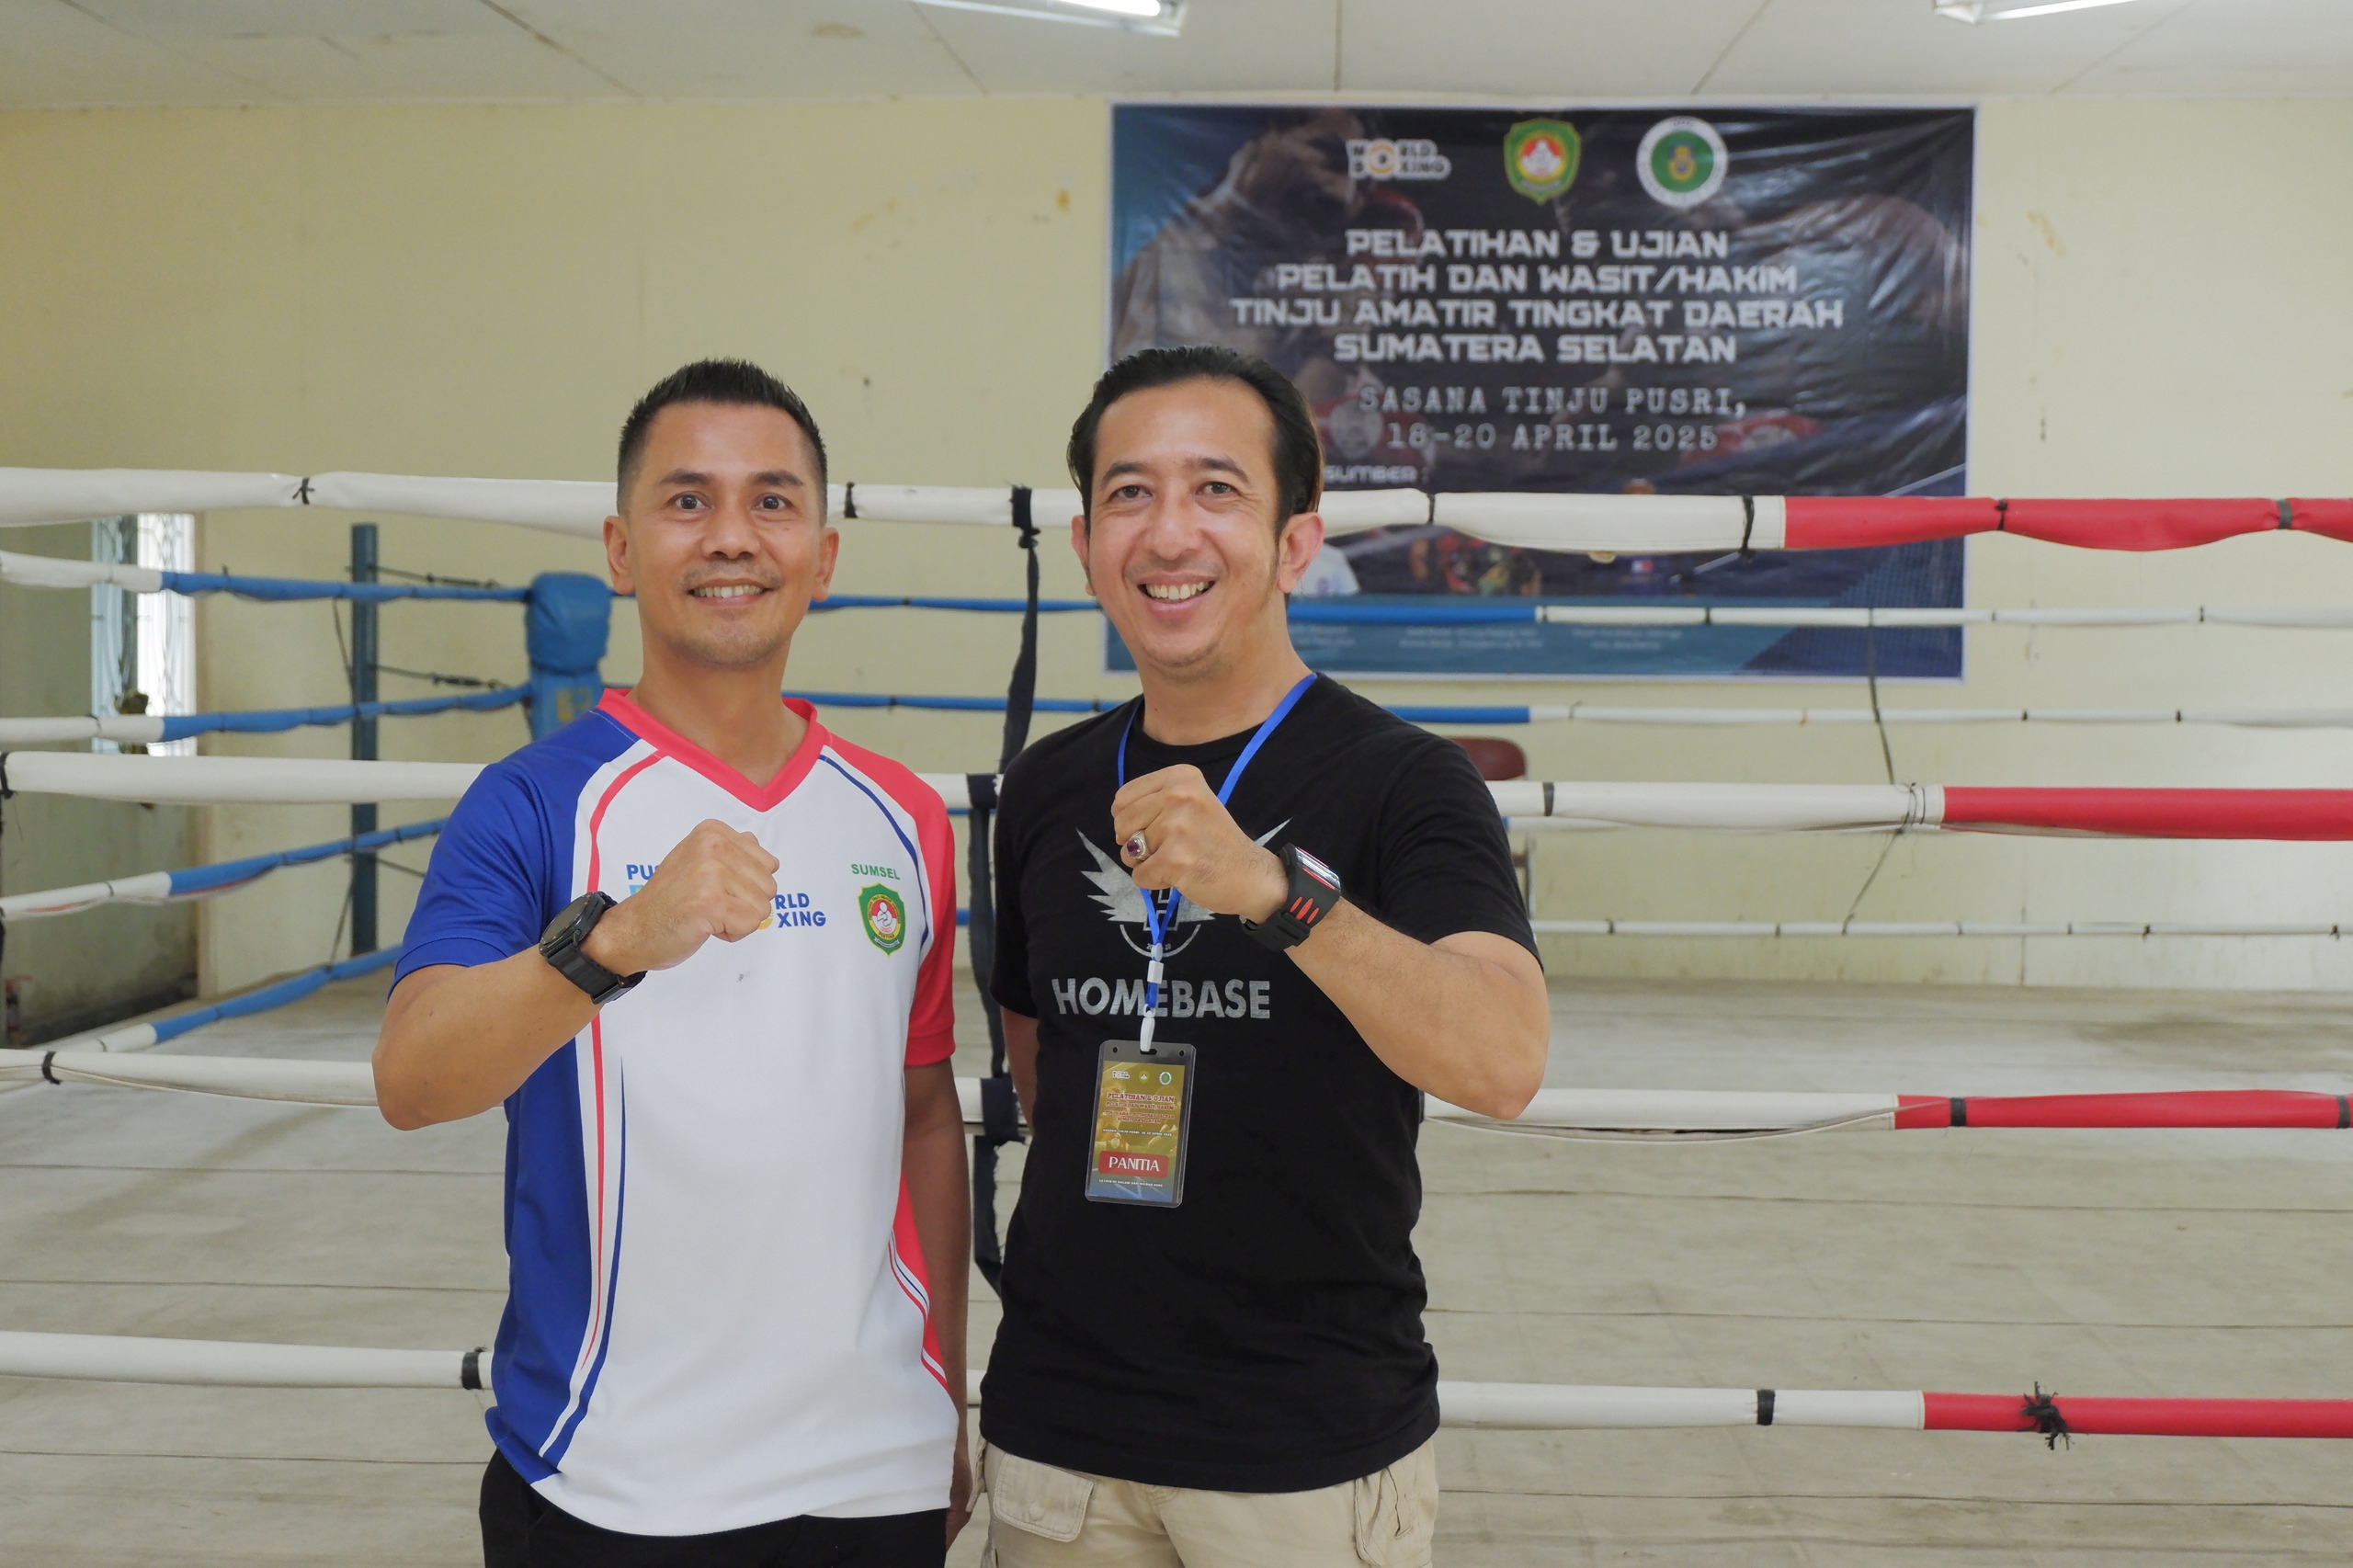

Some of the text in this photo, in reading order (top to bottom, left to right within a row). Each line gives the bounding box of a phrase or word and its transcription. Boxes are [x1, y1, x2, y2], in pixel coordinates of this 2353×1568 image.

[1346, 229, 1729, 258] PELATIHAN & UJIAN
[1276, 263, 1798, 293] PELATIH DAN WASIT/HAKIM
[1229, 297, 1844, 329] TINJU AMATIR TINGKAT DAERAH
[1335, 333, 1737, 363] SUMATERA SELATAN
[1358, 386, 1745, 419] SASANA TINJU PUSRI,
[1387, 422, 1718, 451] 18-20 APRIL 2025
[851, 863, 901, 881] SUMSEL
[775, 892, 810, 909] RLD
[777, 911, 826, 928] XING
[1051, 977, 1270, 1019] HOMEBASE
[1108, 1156, 1160, 1172] PANITIA
